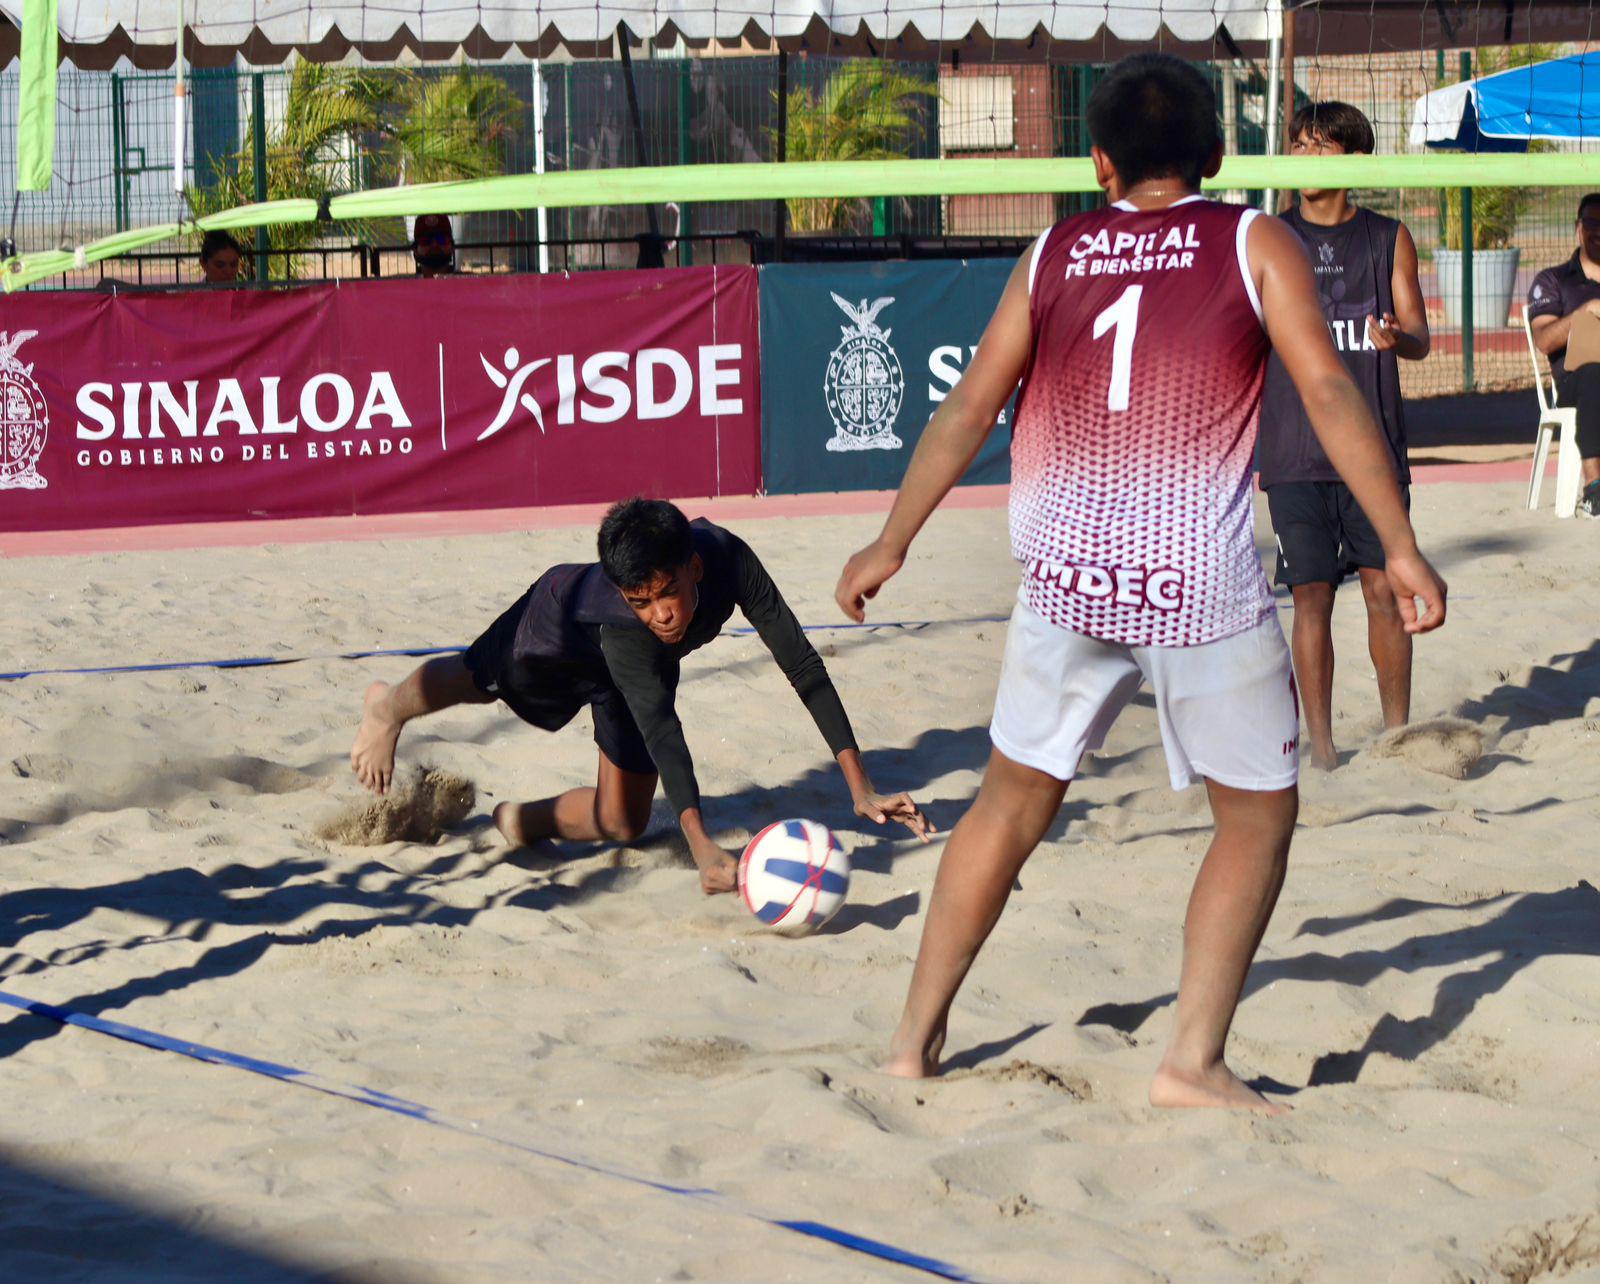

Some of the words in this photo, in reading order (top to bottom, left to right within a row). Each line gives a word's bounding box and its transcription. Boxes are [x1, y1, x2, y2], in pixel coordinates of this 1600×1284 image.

[557, 343, 743, 425] ISDE
[1093, 284, 1144, 412] 1
[76, 371, 412, 440] SINALOA
[77, 447, 224, 466] GOBIERNO
[242, 444, 289, 461] DEL
[307, 438, 413, 458] ESTADO
